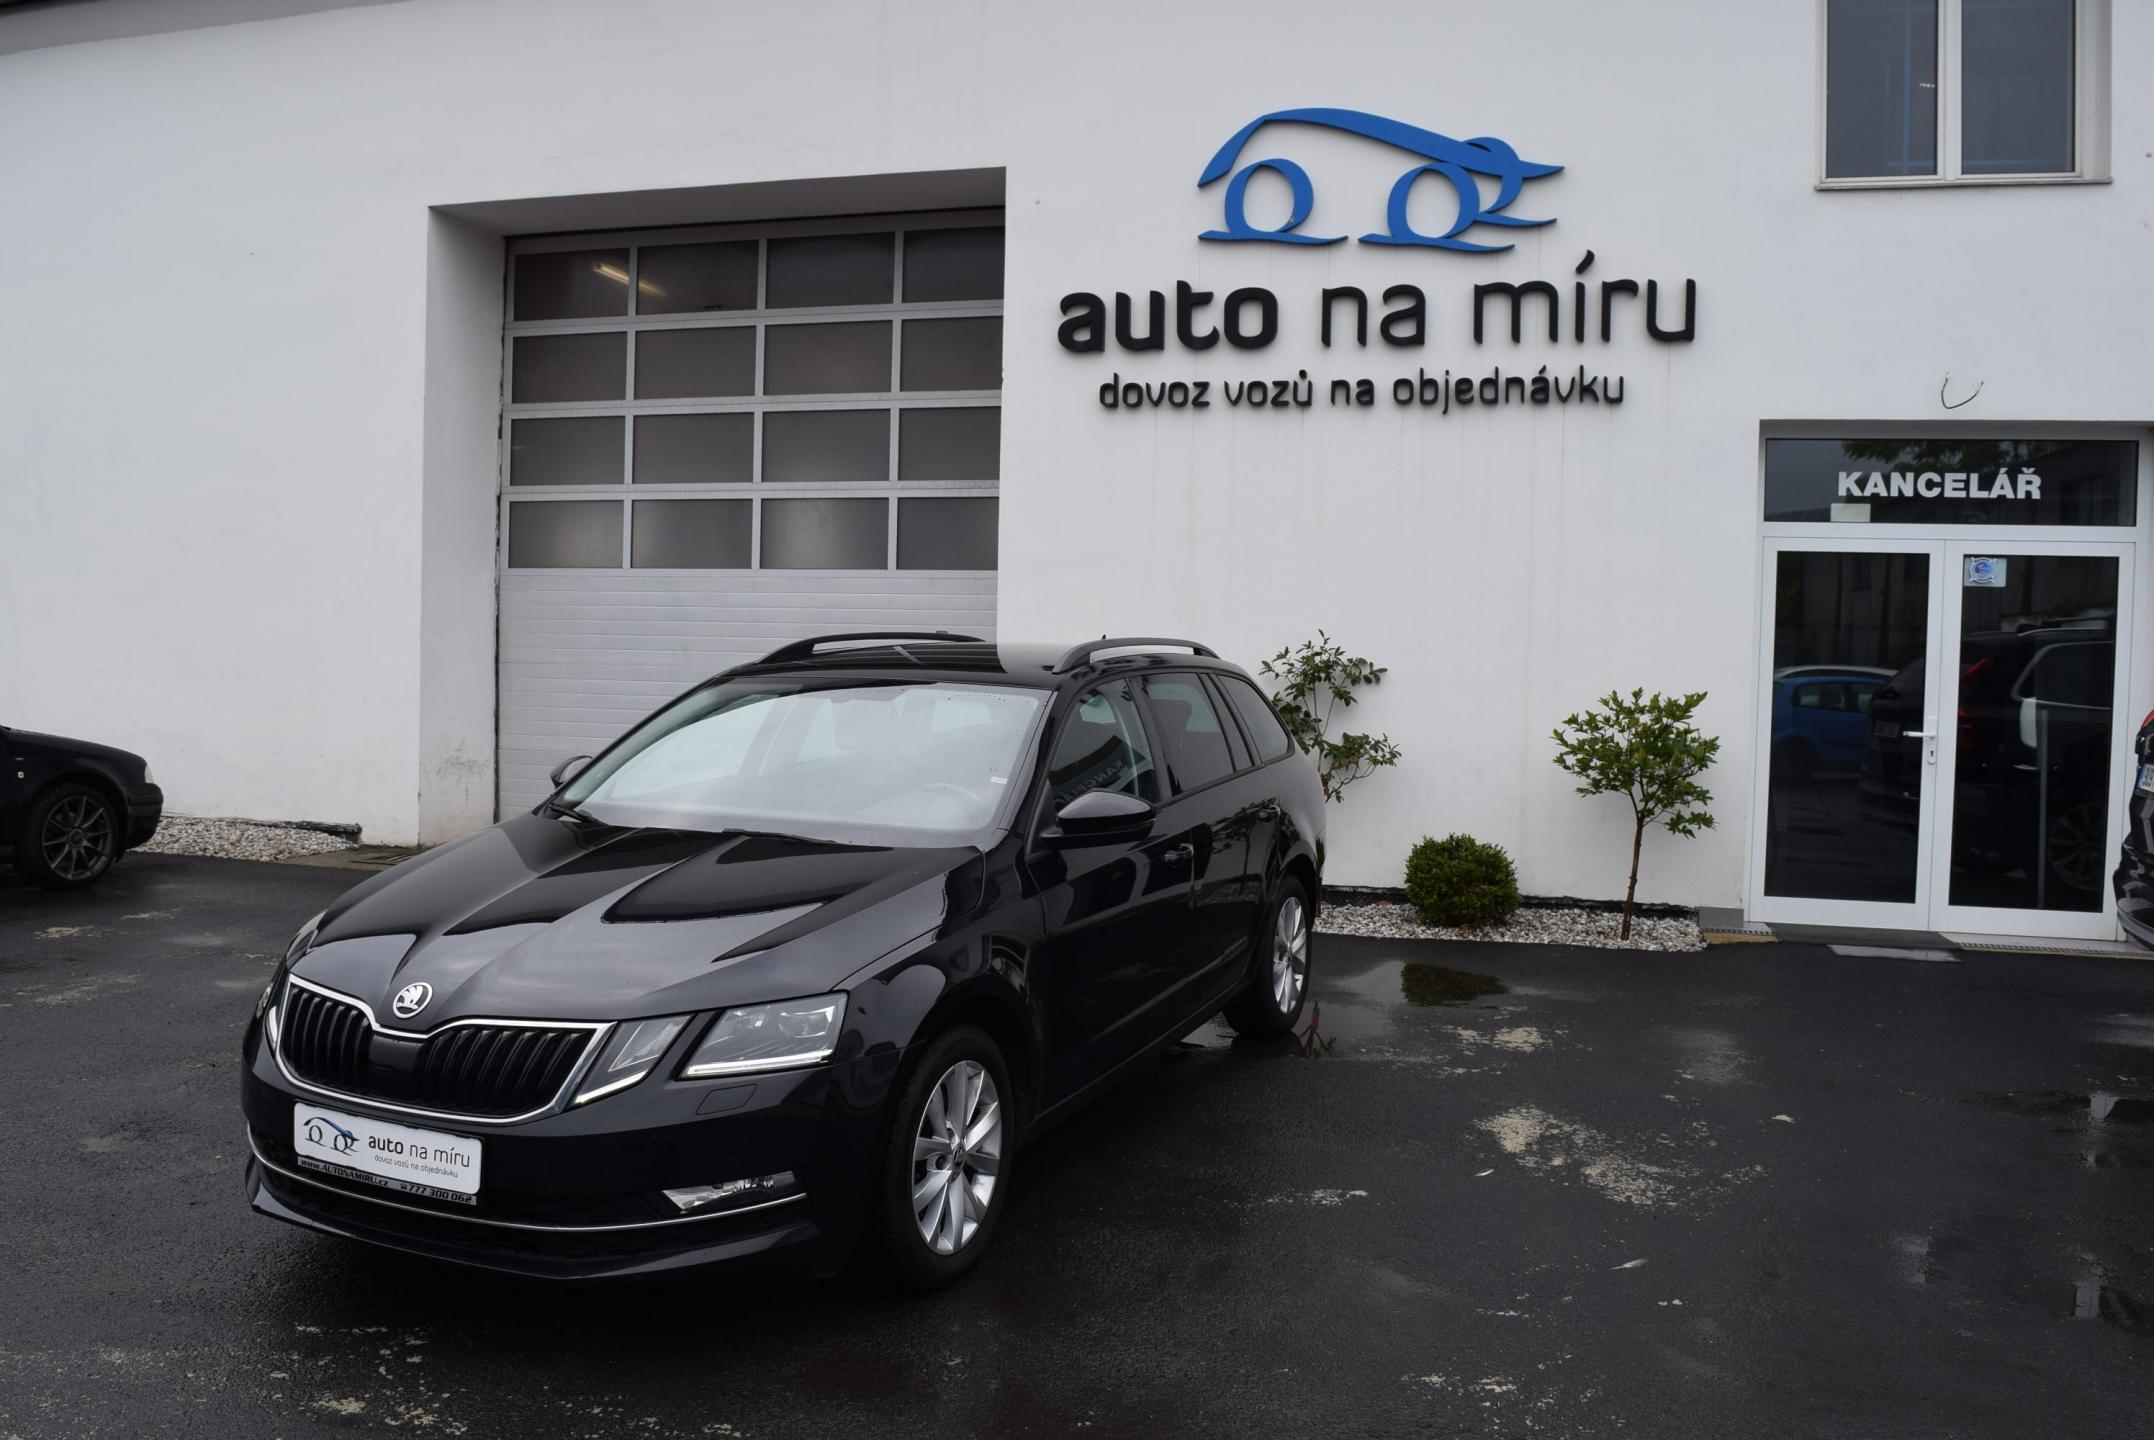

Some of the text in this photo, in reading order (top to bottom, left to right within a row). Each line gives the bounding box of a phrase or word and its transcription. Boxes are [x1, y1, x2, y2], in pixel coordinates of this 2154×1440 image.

[1057, 249, 1697, 352] auto na míru
[1099, 365, 1624, 415] dovoz vozů na objednávku
[1838, 467, 2042, 500] KANCELÁŘ
[368, 1135, 470, 1168] auto na míru
[374, 1154, 393, 1165] dovoz
[429, 1188, 449, 1199] 300
[451, 1192, 473, 1204] 062
